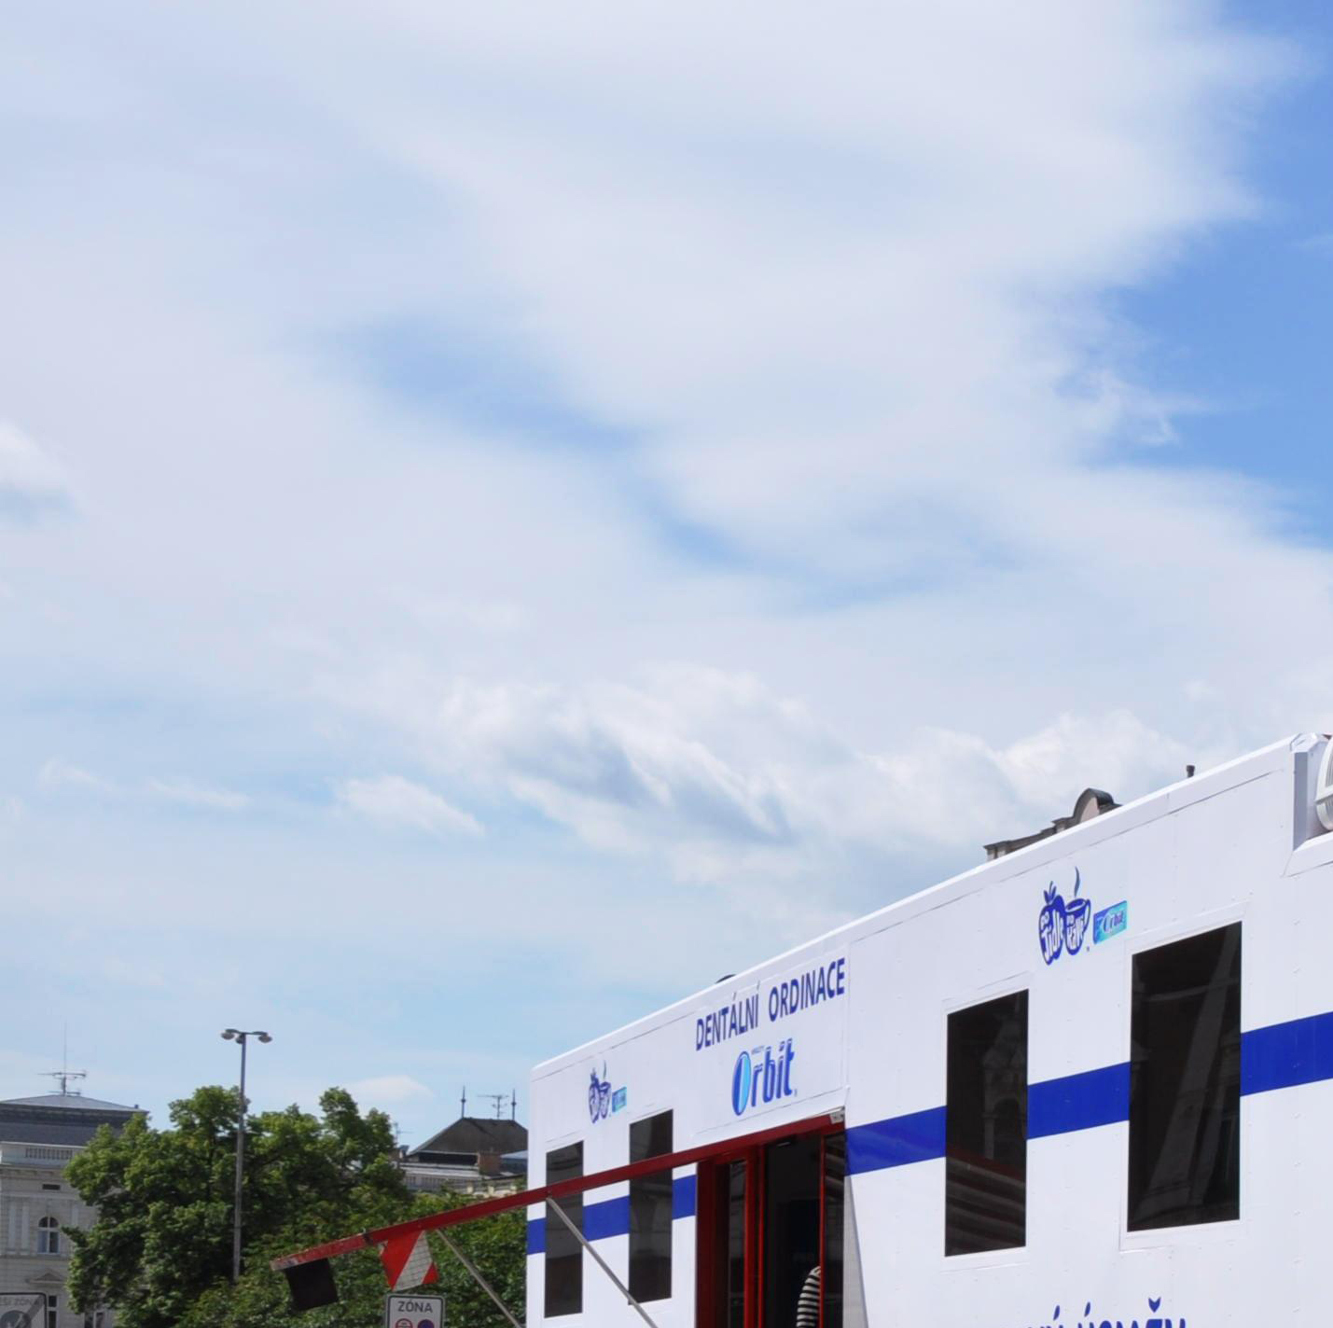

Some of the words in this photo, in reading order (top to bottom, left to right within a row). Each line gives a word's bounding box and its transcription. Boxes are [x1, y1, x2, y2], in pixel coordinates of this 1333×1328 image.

[696, 980, 760, 1051] DENTÁLNÍ
[769, 957, 846, 1022] ORDINACE
[731, 1038, 795, 1116] Orbit
[397, 1298, 434, 1313] ZÓNA
